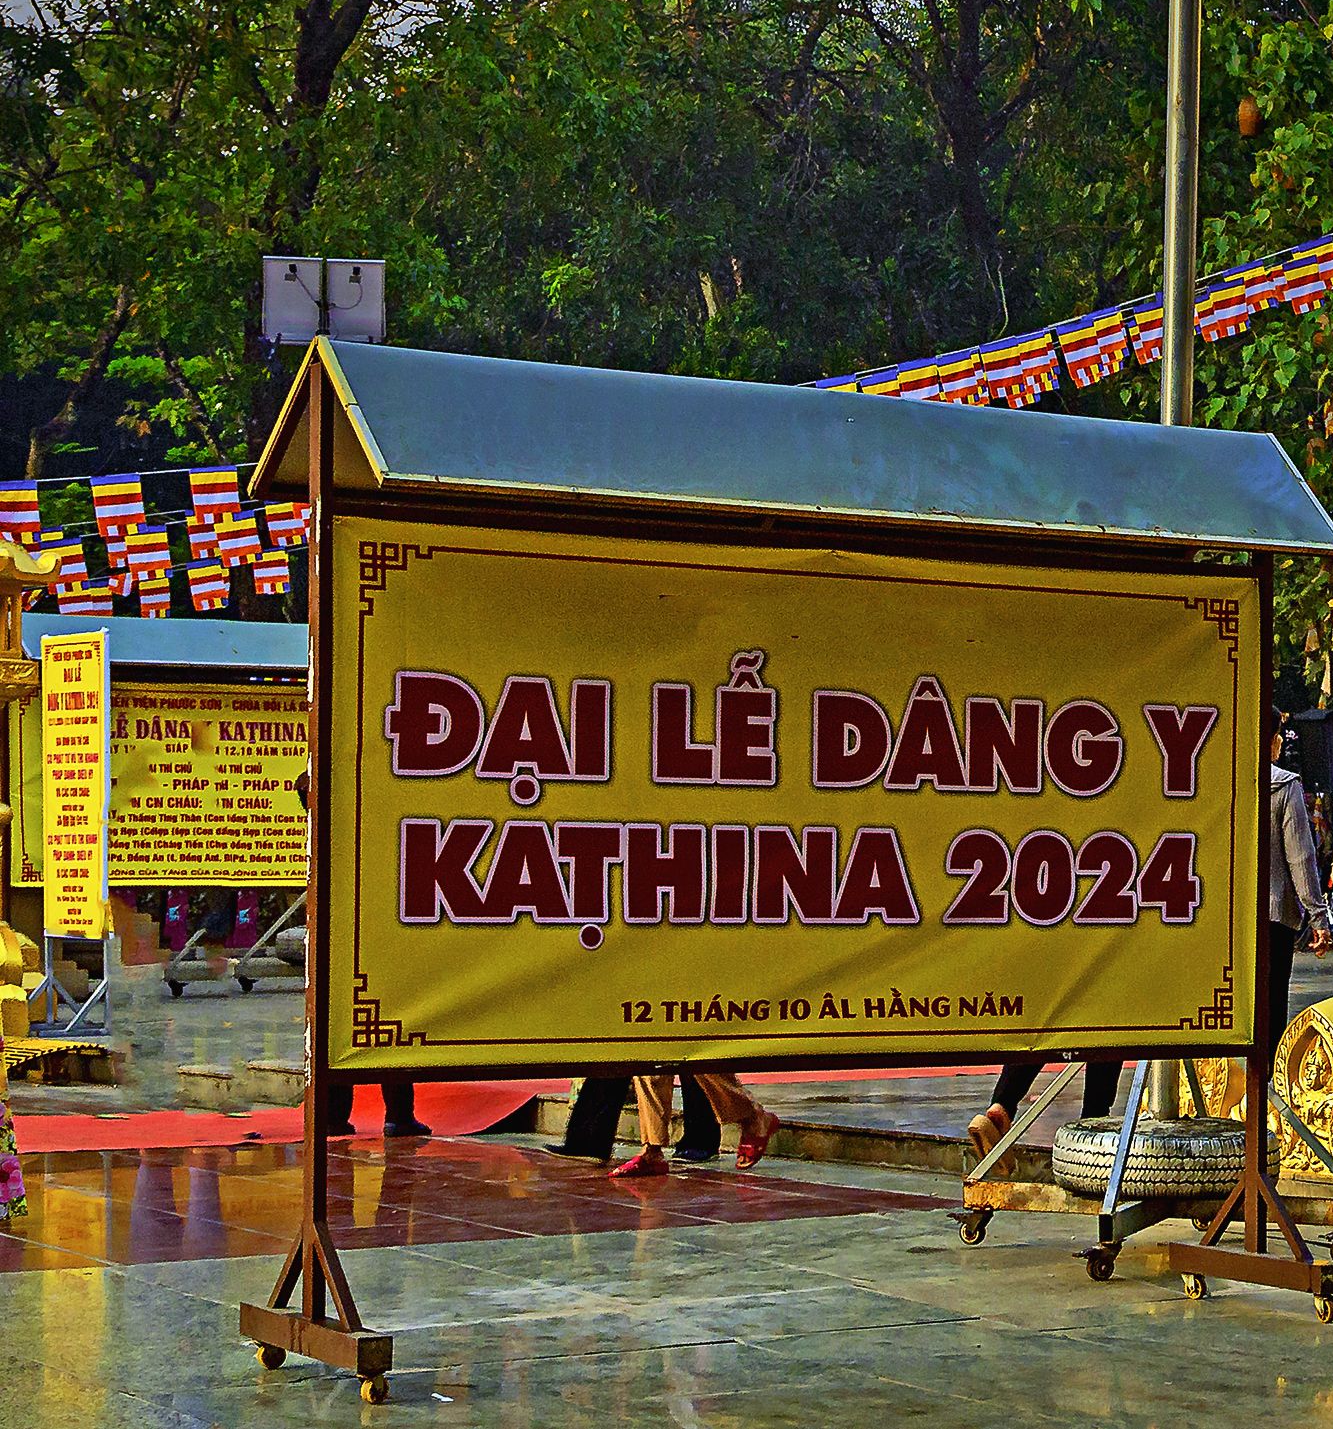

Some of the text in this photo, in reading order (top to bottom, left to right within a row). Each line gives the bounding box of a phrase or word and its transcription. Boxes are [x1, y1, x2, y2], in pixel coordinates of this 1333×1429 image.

[385, 649, 1218, 804] ĐẠI LỄ DÂNG Y
[943, 829, 1200, 925] 2024
[621, 987, 1024, 1023] 12 THÁNG 10 ÂL HẰNG NĂM
